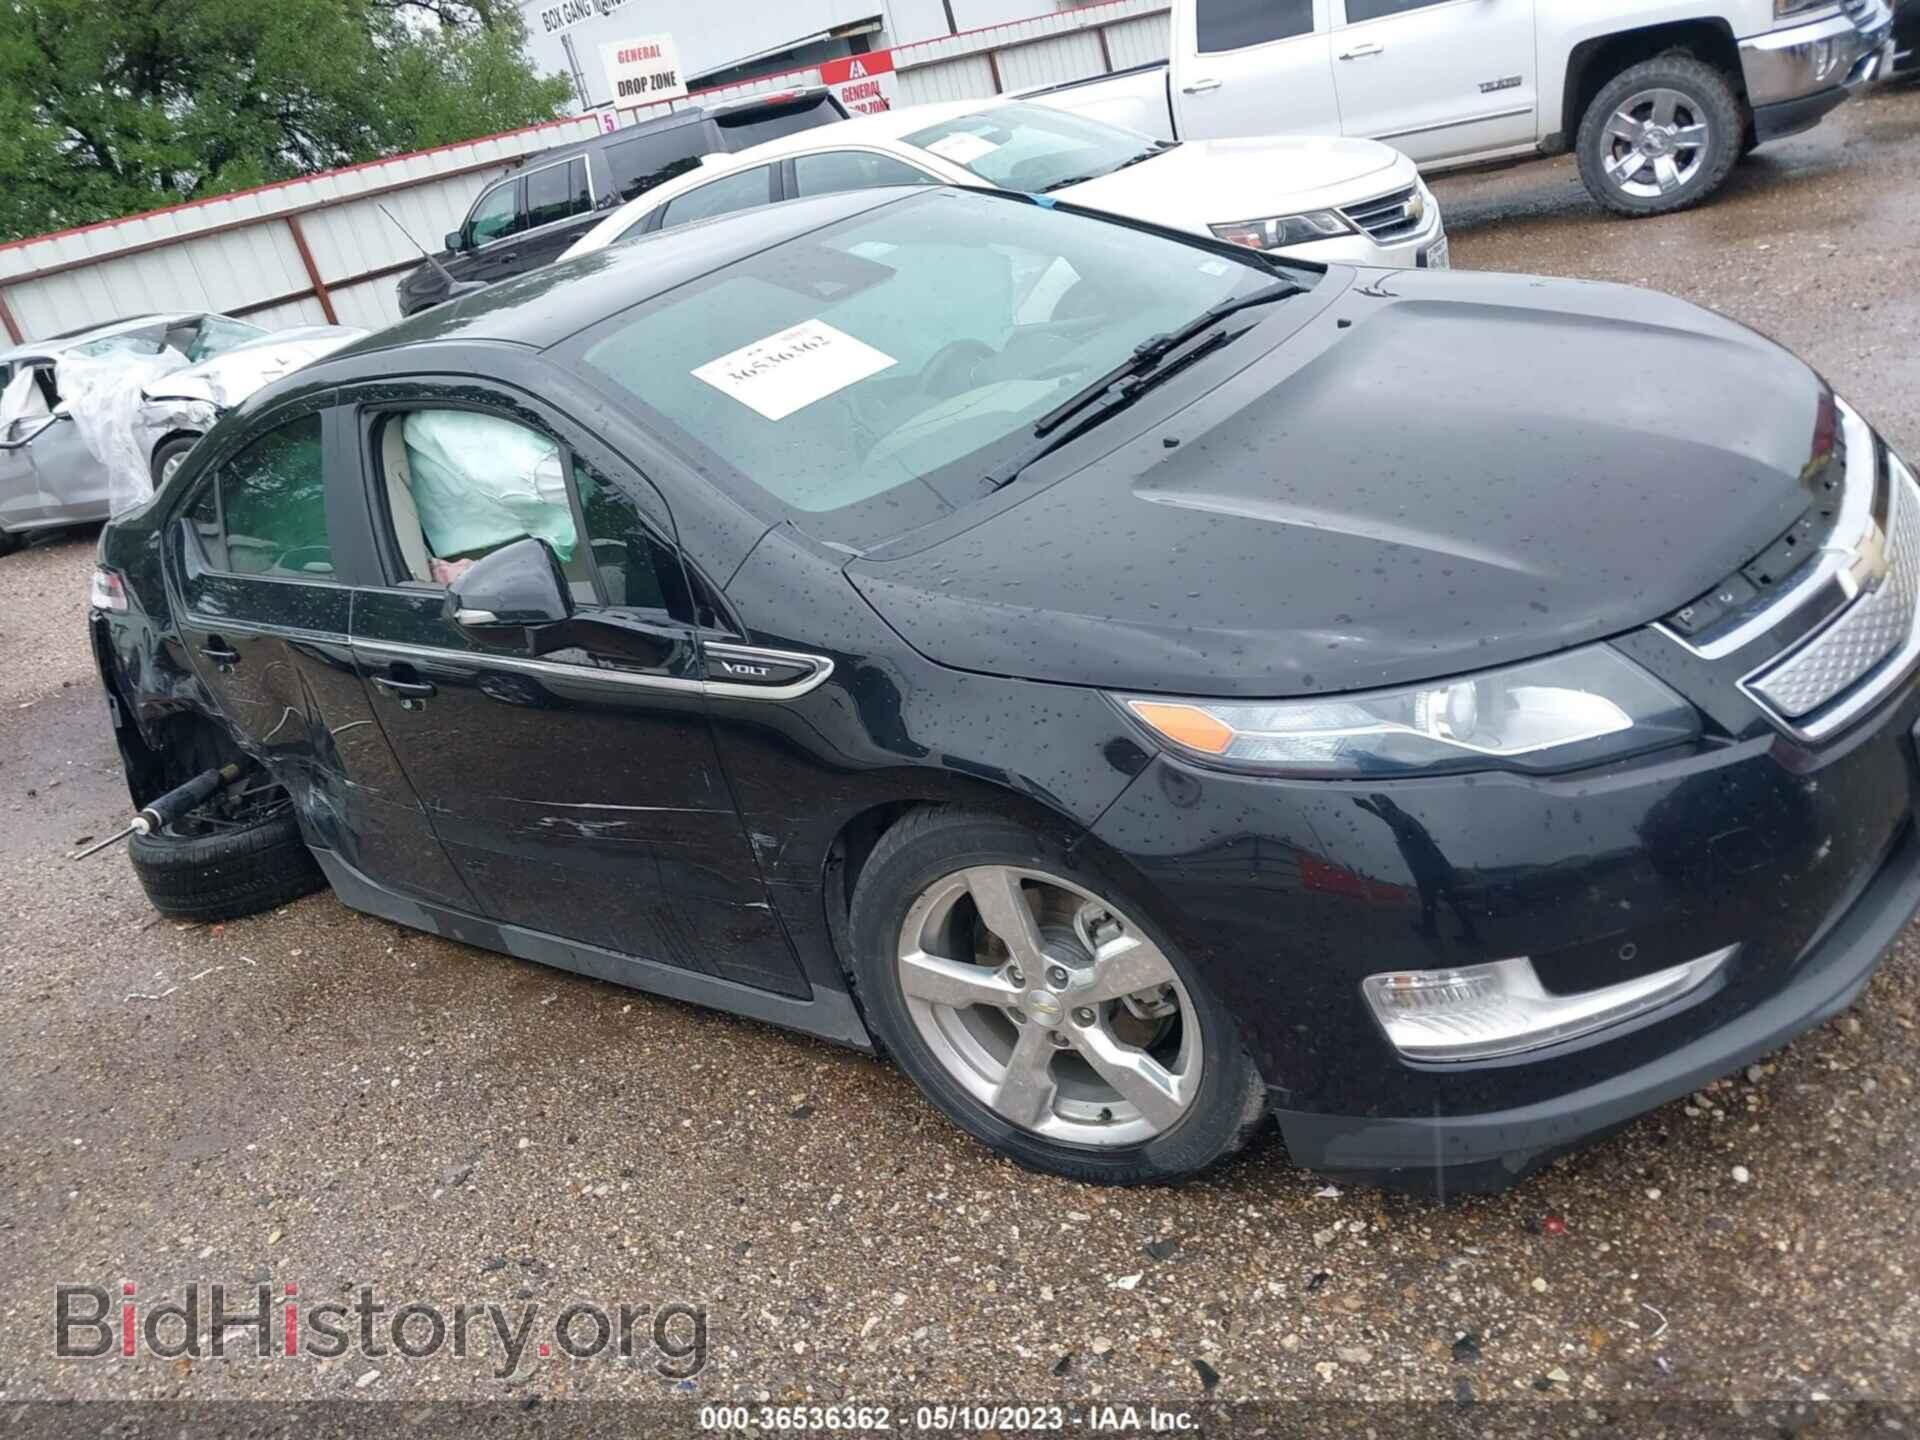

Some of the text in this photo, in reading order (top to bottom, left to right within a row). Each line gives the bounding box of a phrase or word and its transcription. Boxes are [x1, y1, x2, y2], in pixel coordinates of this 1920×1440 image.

[541, 7, 564, 32] BOX
[562, 0, 591, 24] GANG
[618, 45, 661, 64] GENERAL
[617, 71, 677, 97] DROP ZONE
[842, 80, 880, 104] GENERAL
[603, 113, 615, 133] 5
[721, 661, 769, 676] VOLT
